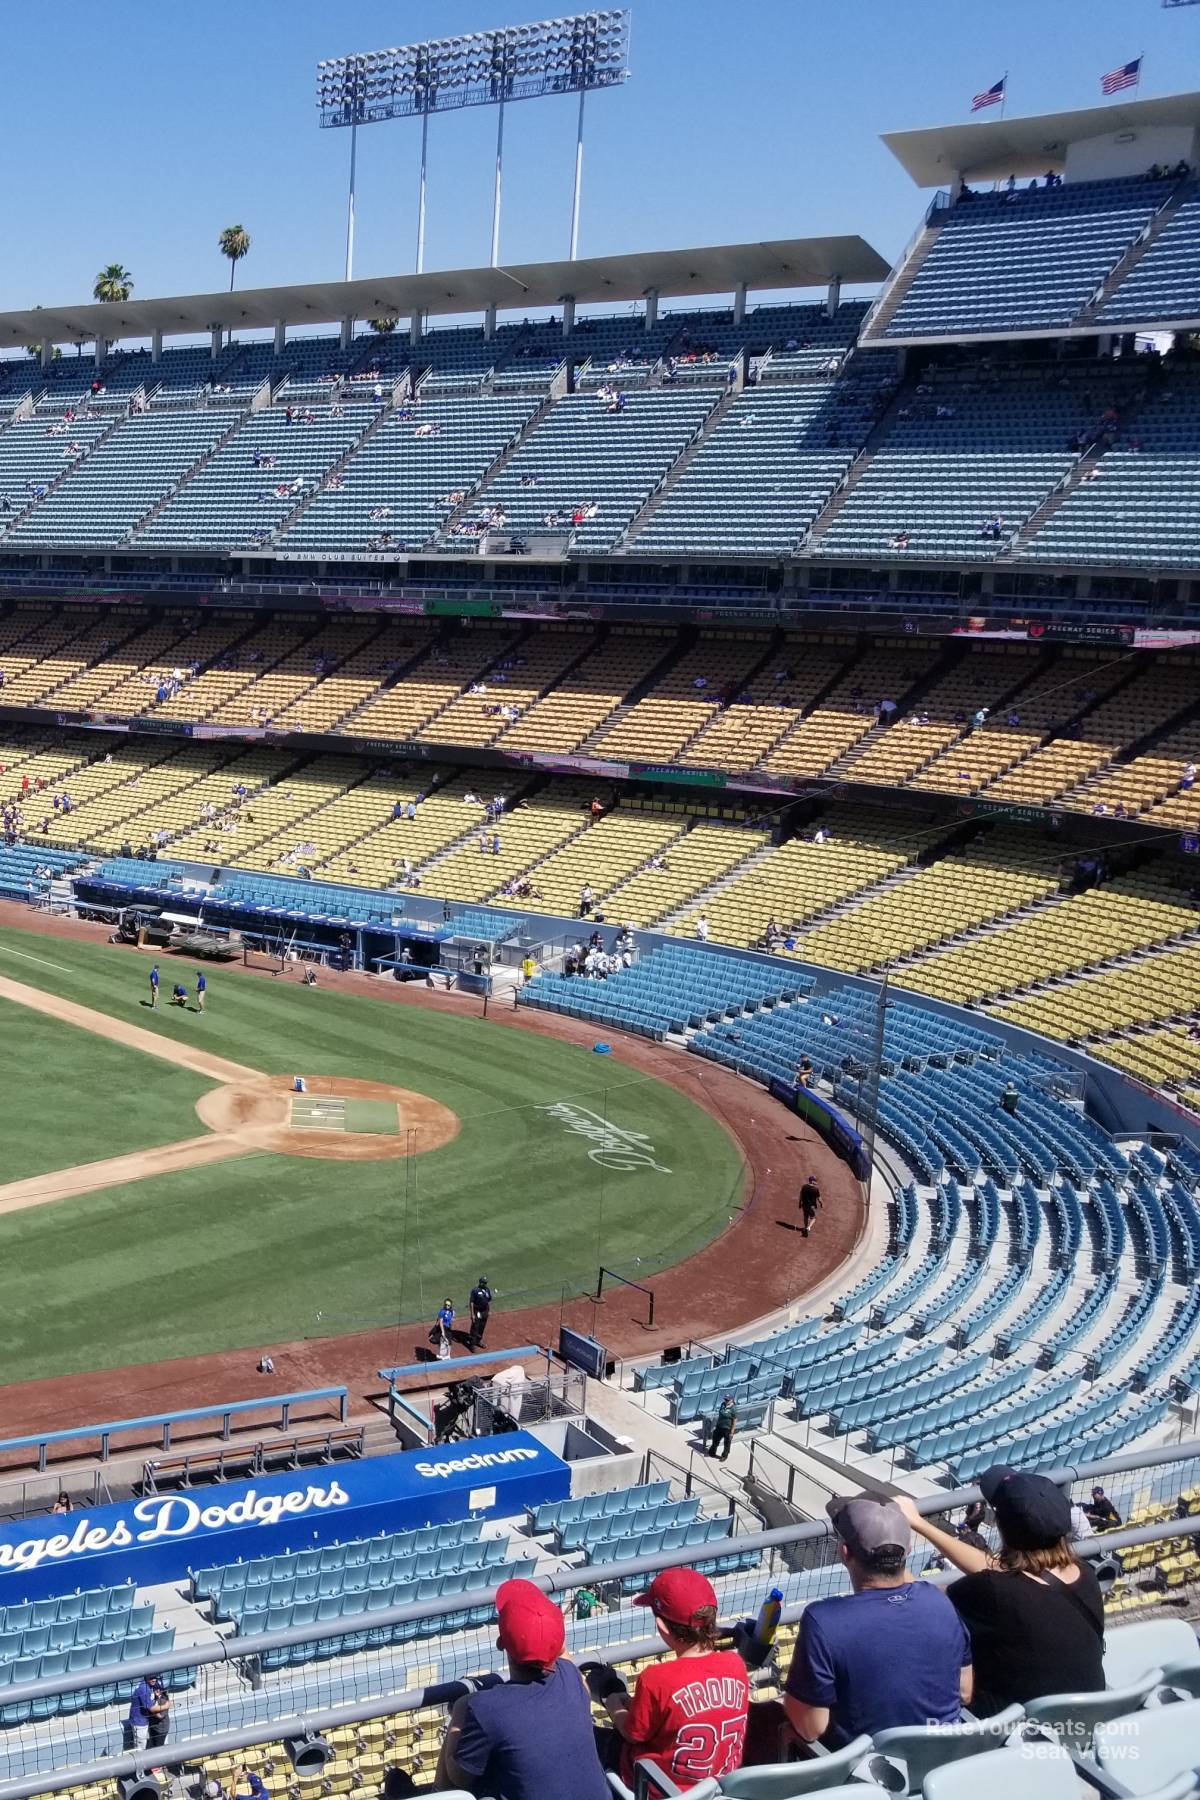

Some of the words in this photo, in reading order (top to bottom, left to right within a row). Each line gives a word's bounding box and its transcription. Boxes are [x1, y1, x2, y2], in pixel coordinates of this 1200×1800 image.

[1047, 625, 1083, 633] FREEWAY
[1086, 627, 1116, 635] SERIES
[534, 1102, 673, 1174] Dodgers
[414, 1448, 533, 1478] Spectrum
[133, 1481, 349, 1542] Dodgers
[671, 1677, 746, 1718] TROUT
[671, 1714, 748, 1781] 27
